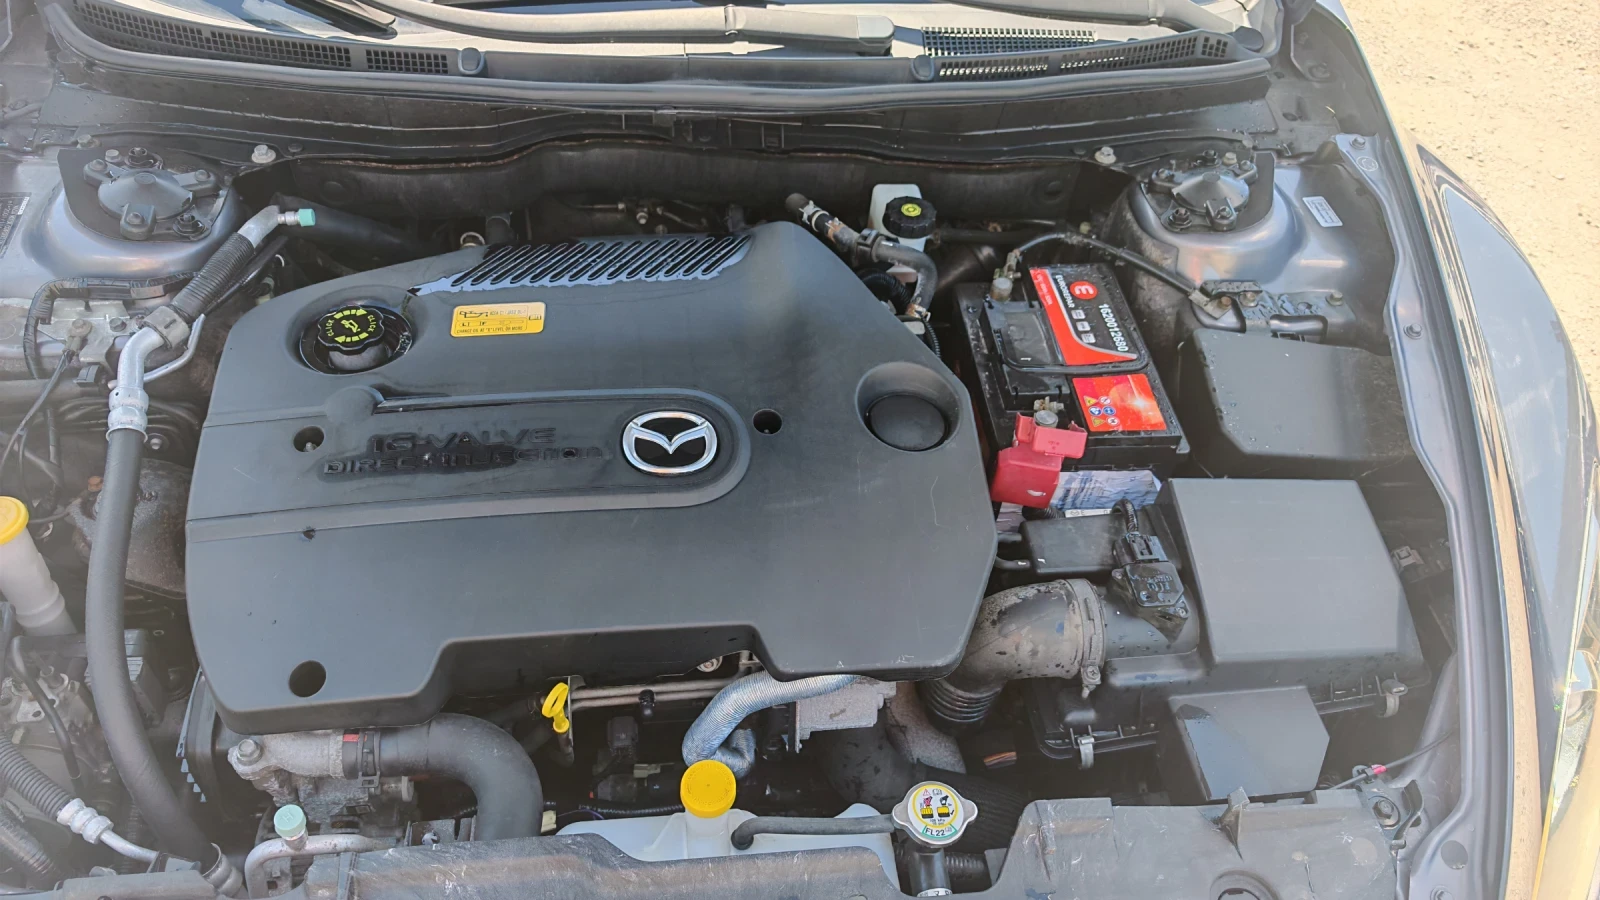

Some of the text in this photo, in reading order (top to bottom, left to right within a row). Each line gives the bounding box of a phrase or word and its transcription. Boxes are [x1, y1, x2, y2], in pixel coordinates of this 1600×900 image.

[1056, 275, 1075, 308] EUROREPAR
[325, 320, 334, 336] CLICK
[367, 315, 376, 332] CLICK
[1099, 304, 1129, 352] 1620012680
[926, 828, 945, 836] FL22
